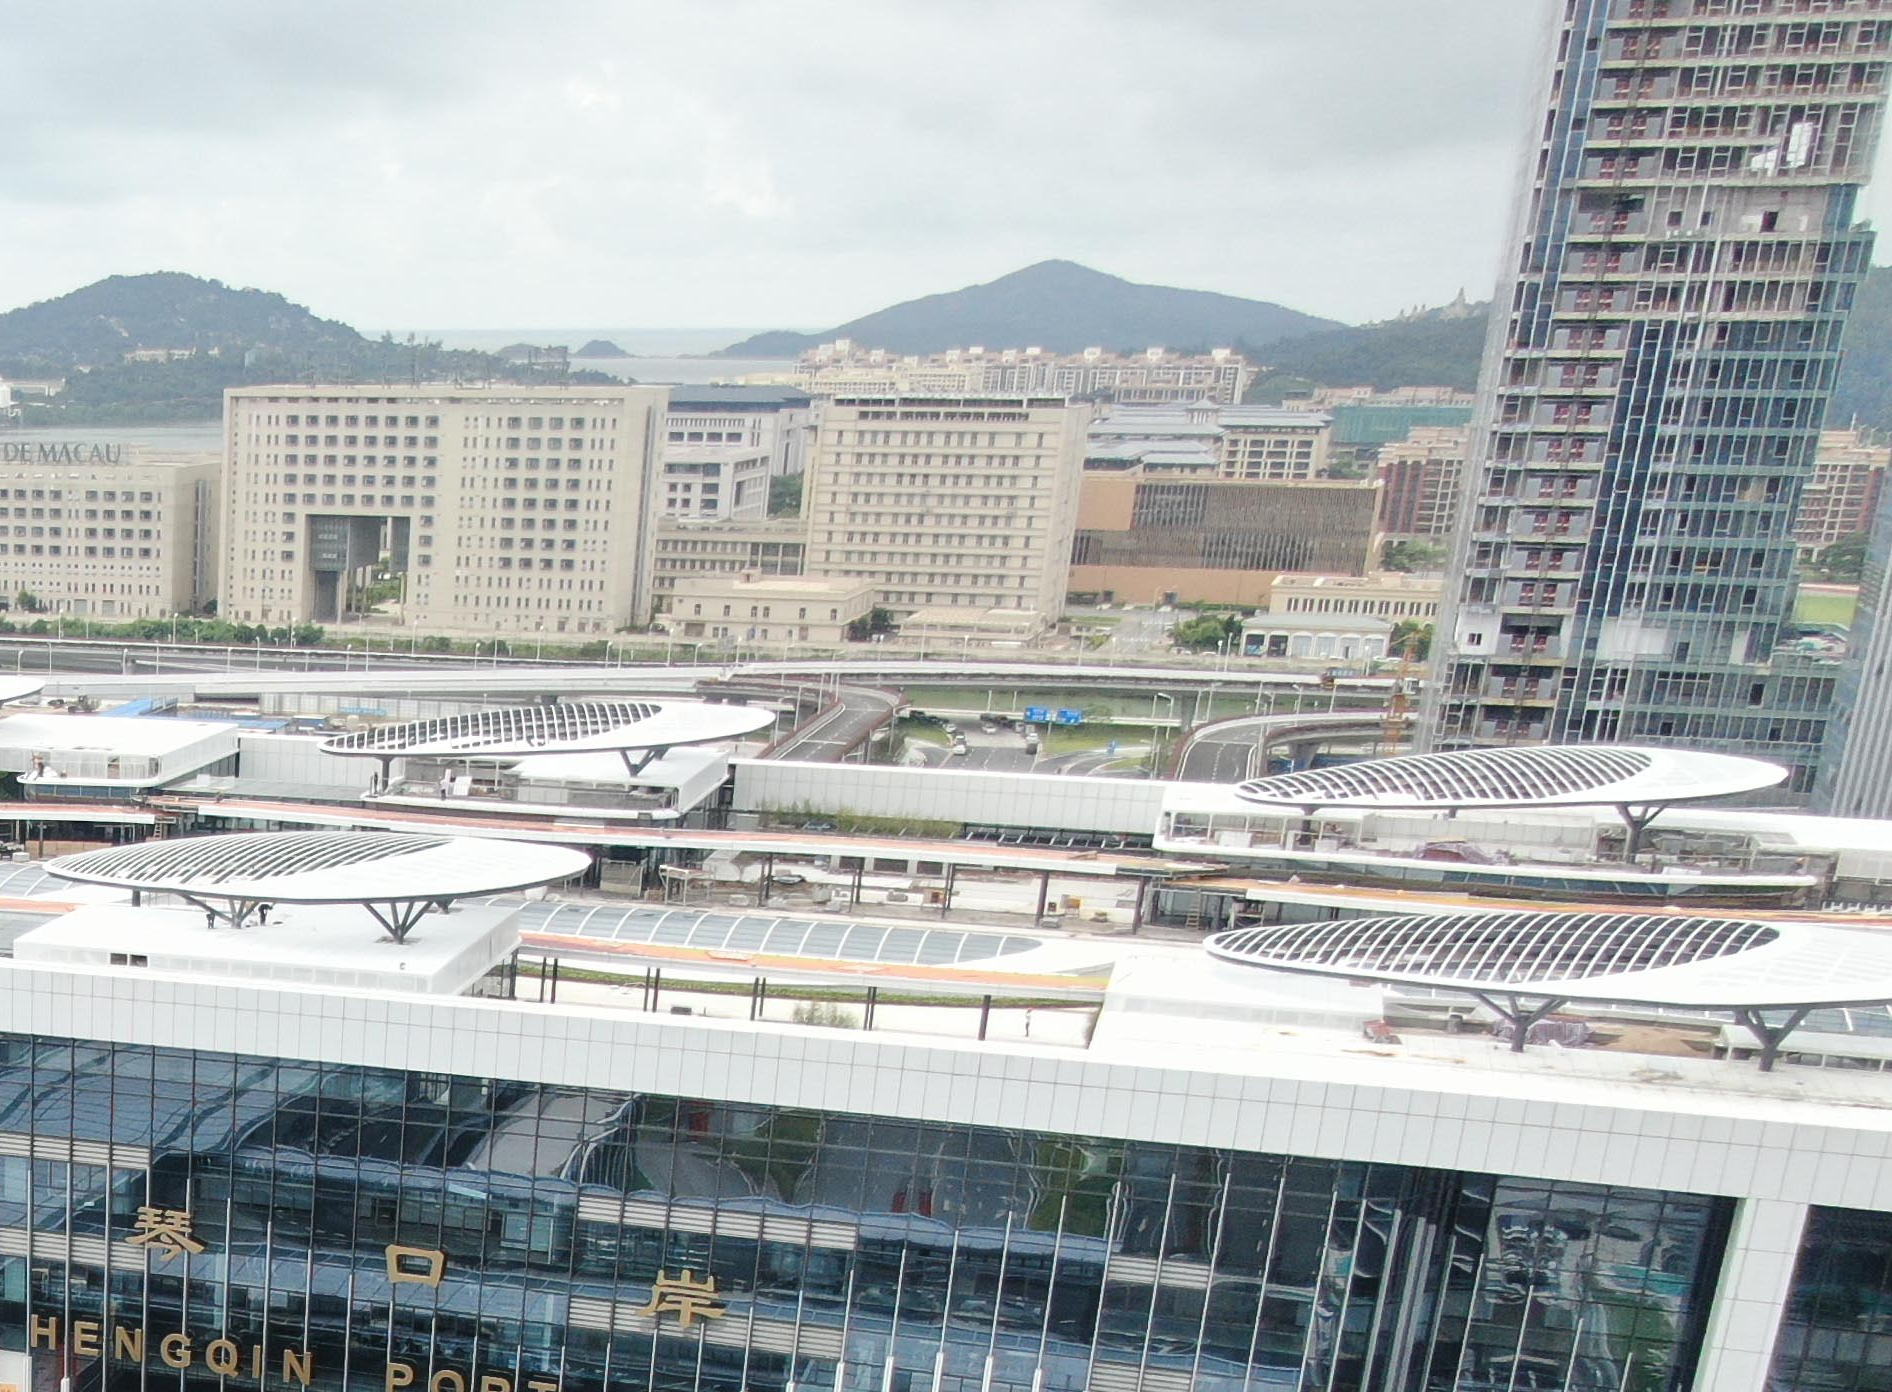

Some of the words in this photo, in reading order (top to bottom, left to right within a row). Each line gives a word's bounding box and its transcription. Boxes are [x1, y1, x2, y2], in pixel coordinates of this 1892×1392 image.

[3, 441, 30, 462] DE
[38, 442, 121, 463] MACAU
[30, 1314, 311, 1386] HENGQIN
